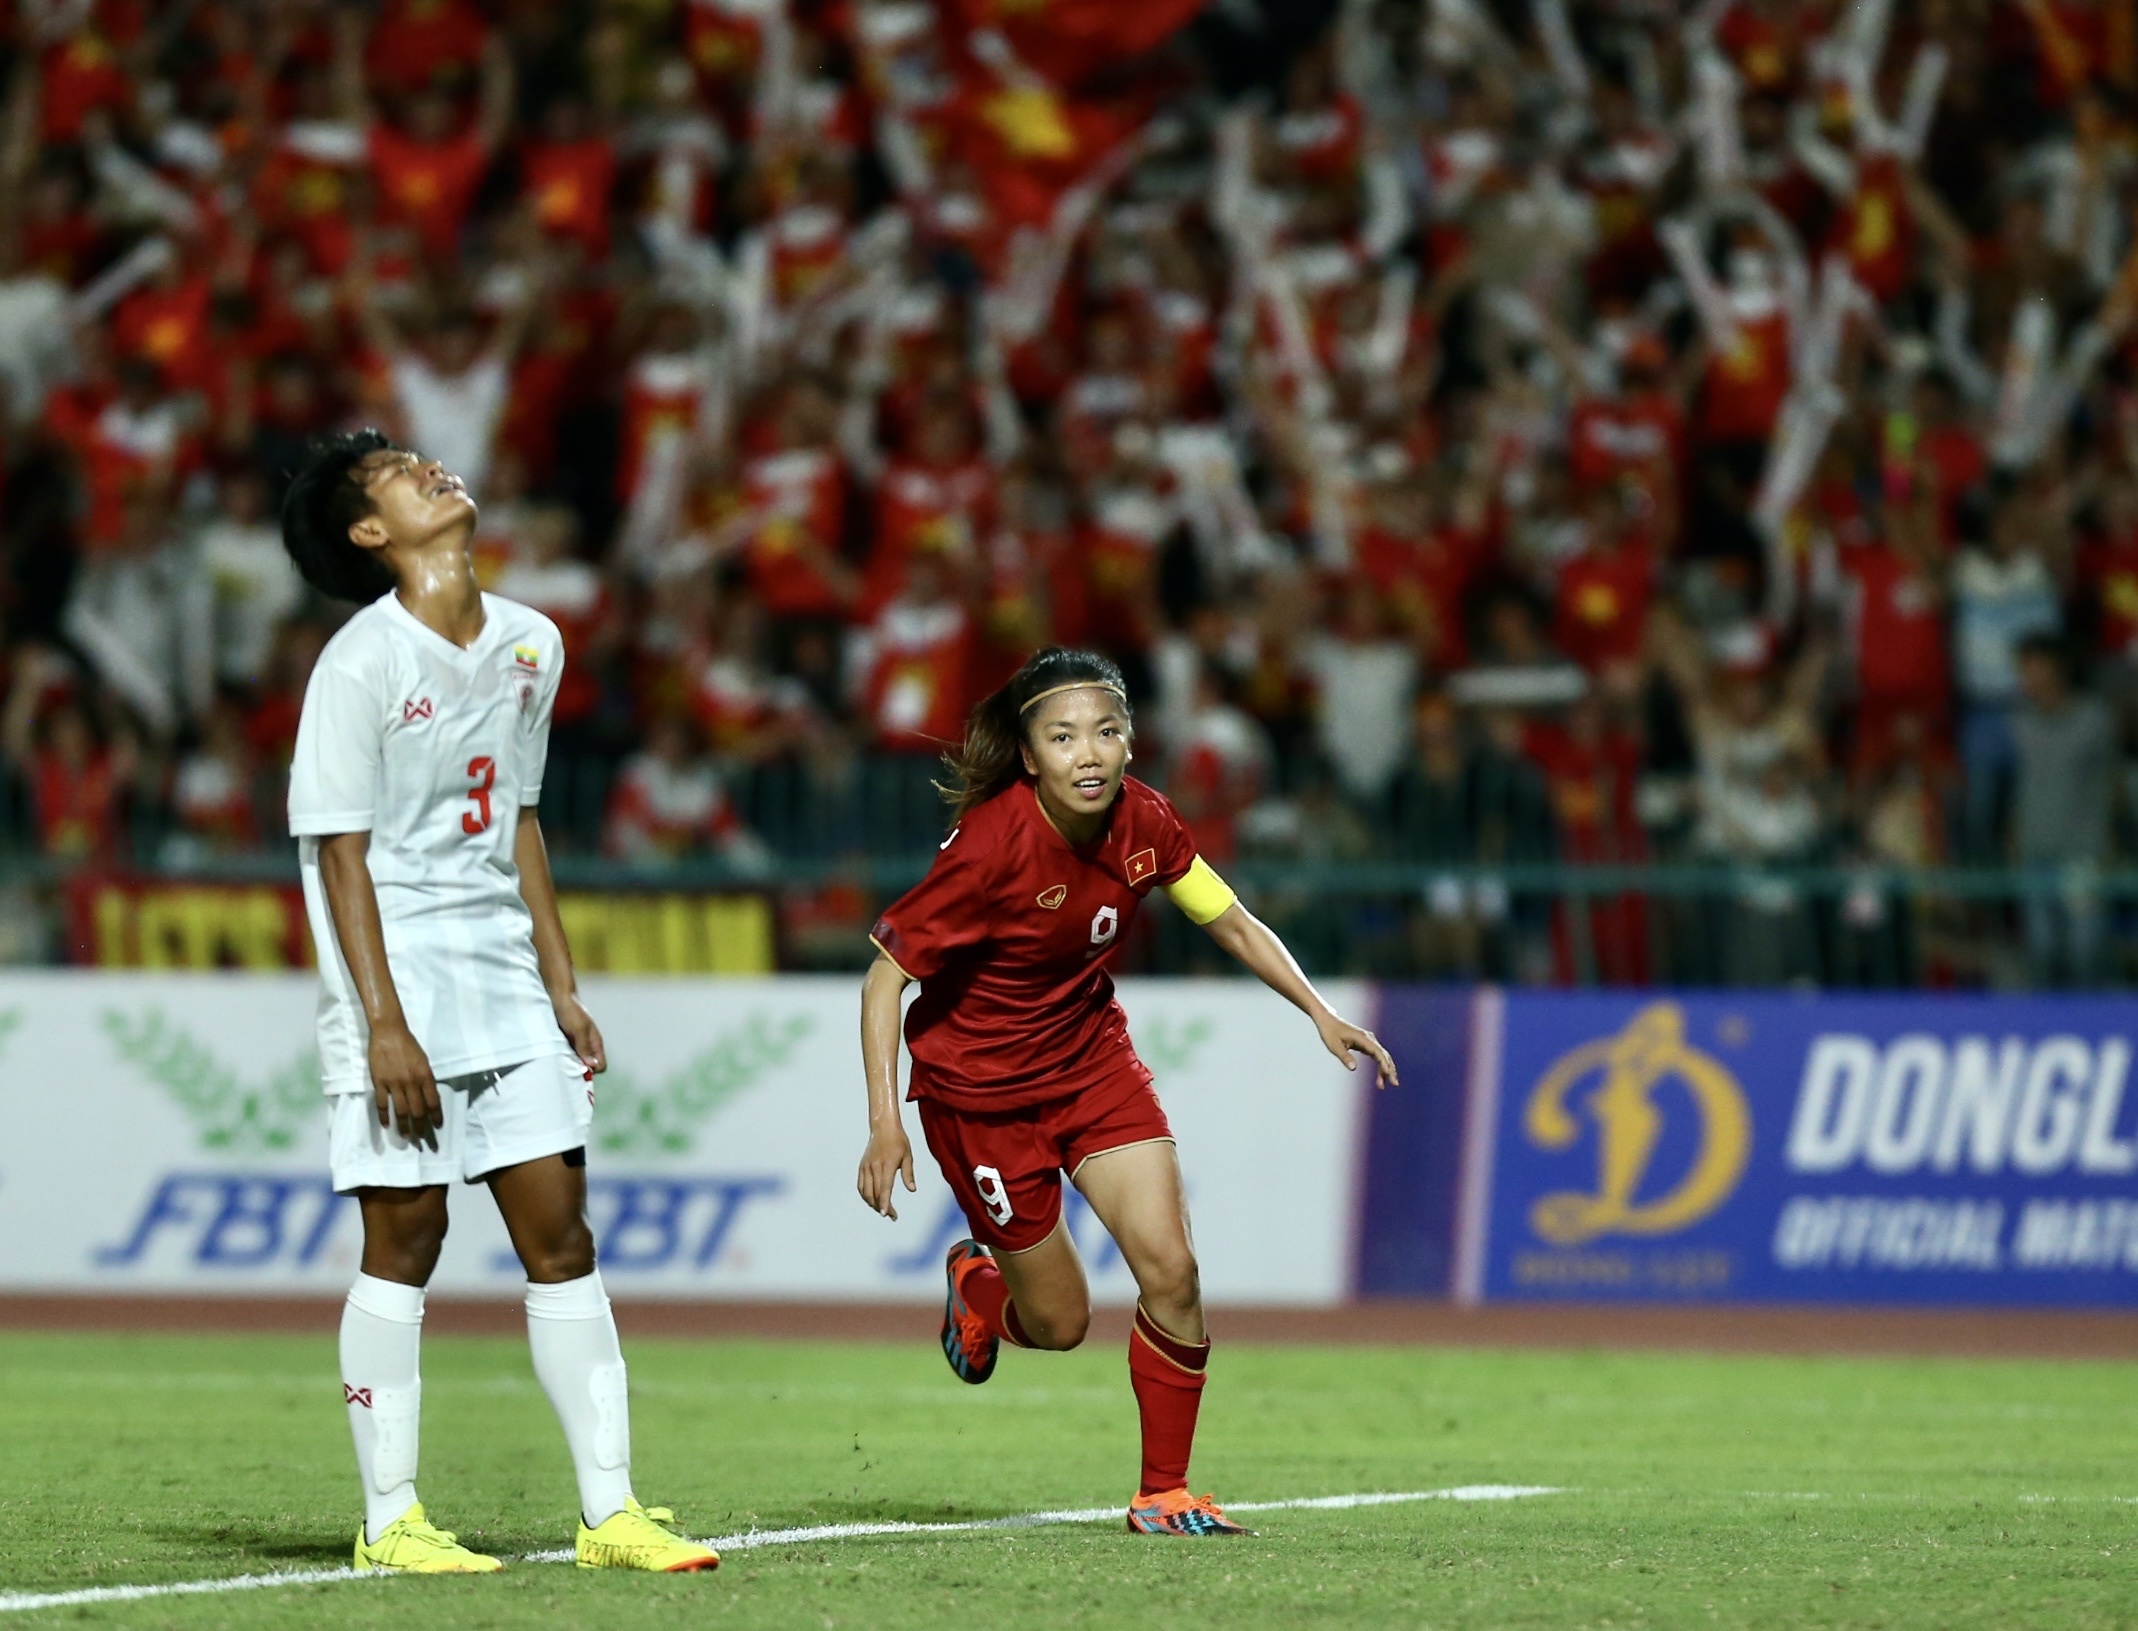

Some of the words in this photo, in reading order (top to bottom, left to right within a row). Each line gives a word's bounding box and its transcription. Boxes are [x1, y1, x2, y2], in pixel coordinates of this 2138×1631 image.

[462, 756, 496, 835] 3
[1087, 905, 1118, 958] 9
[973, 1164, 1014, 1227] 9
